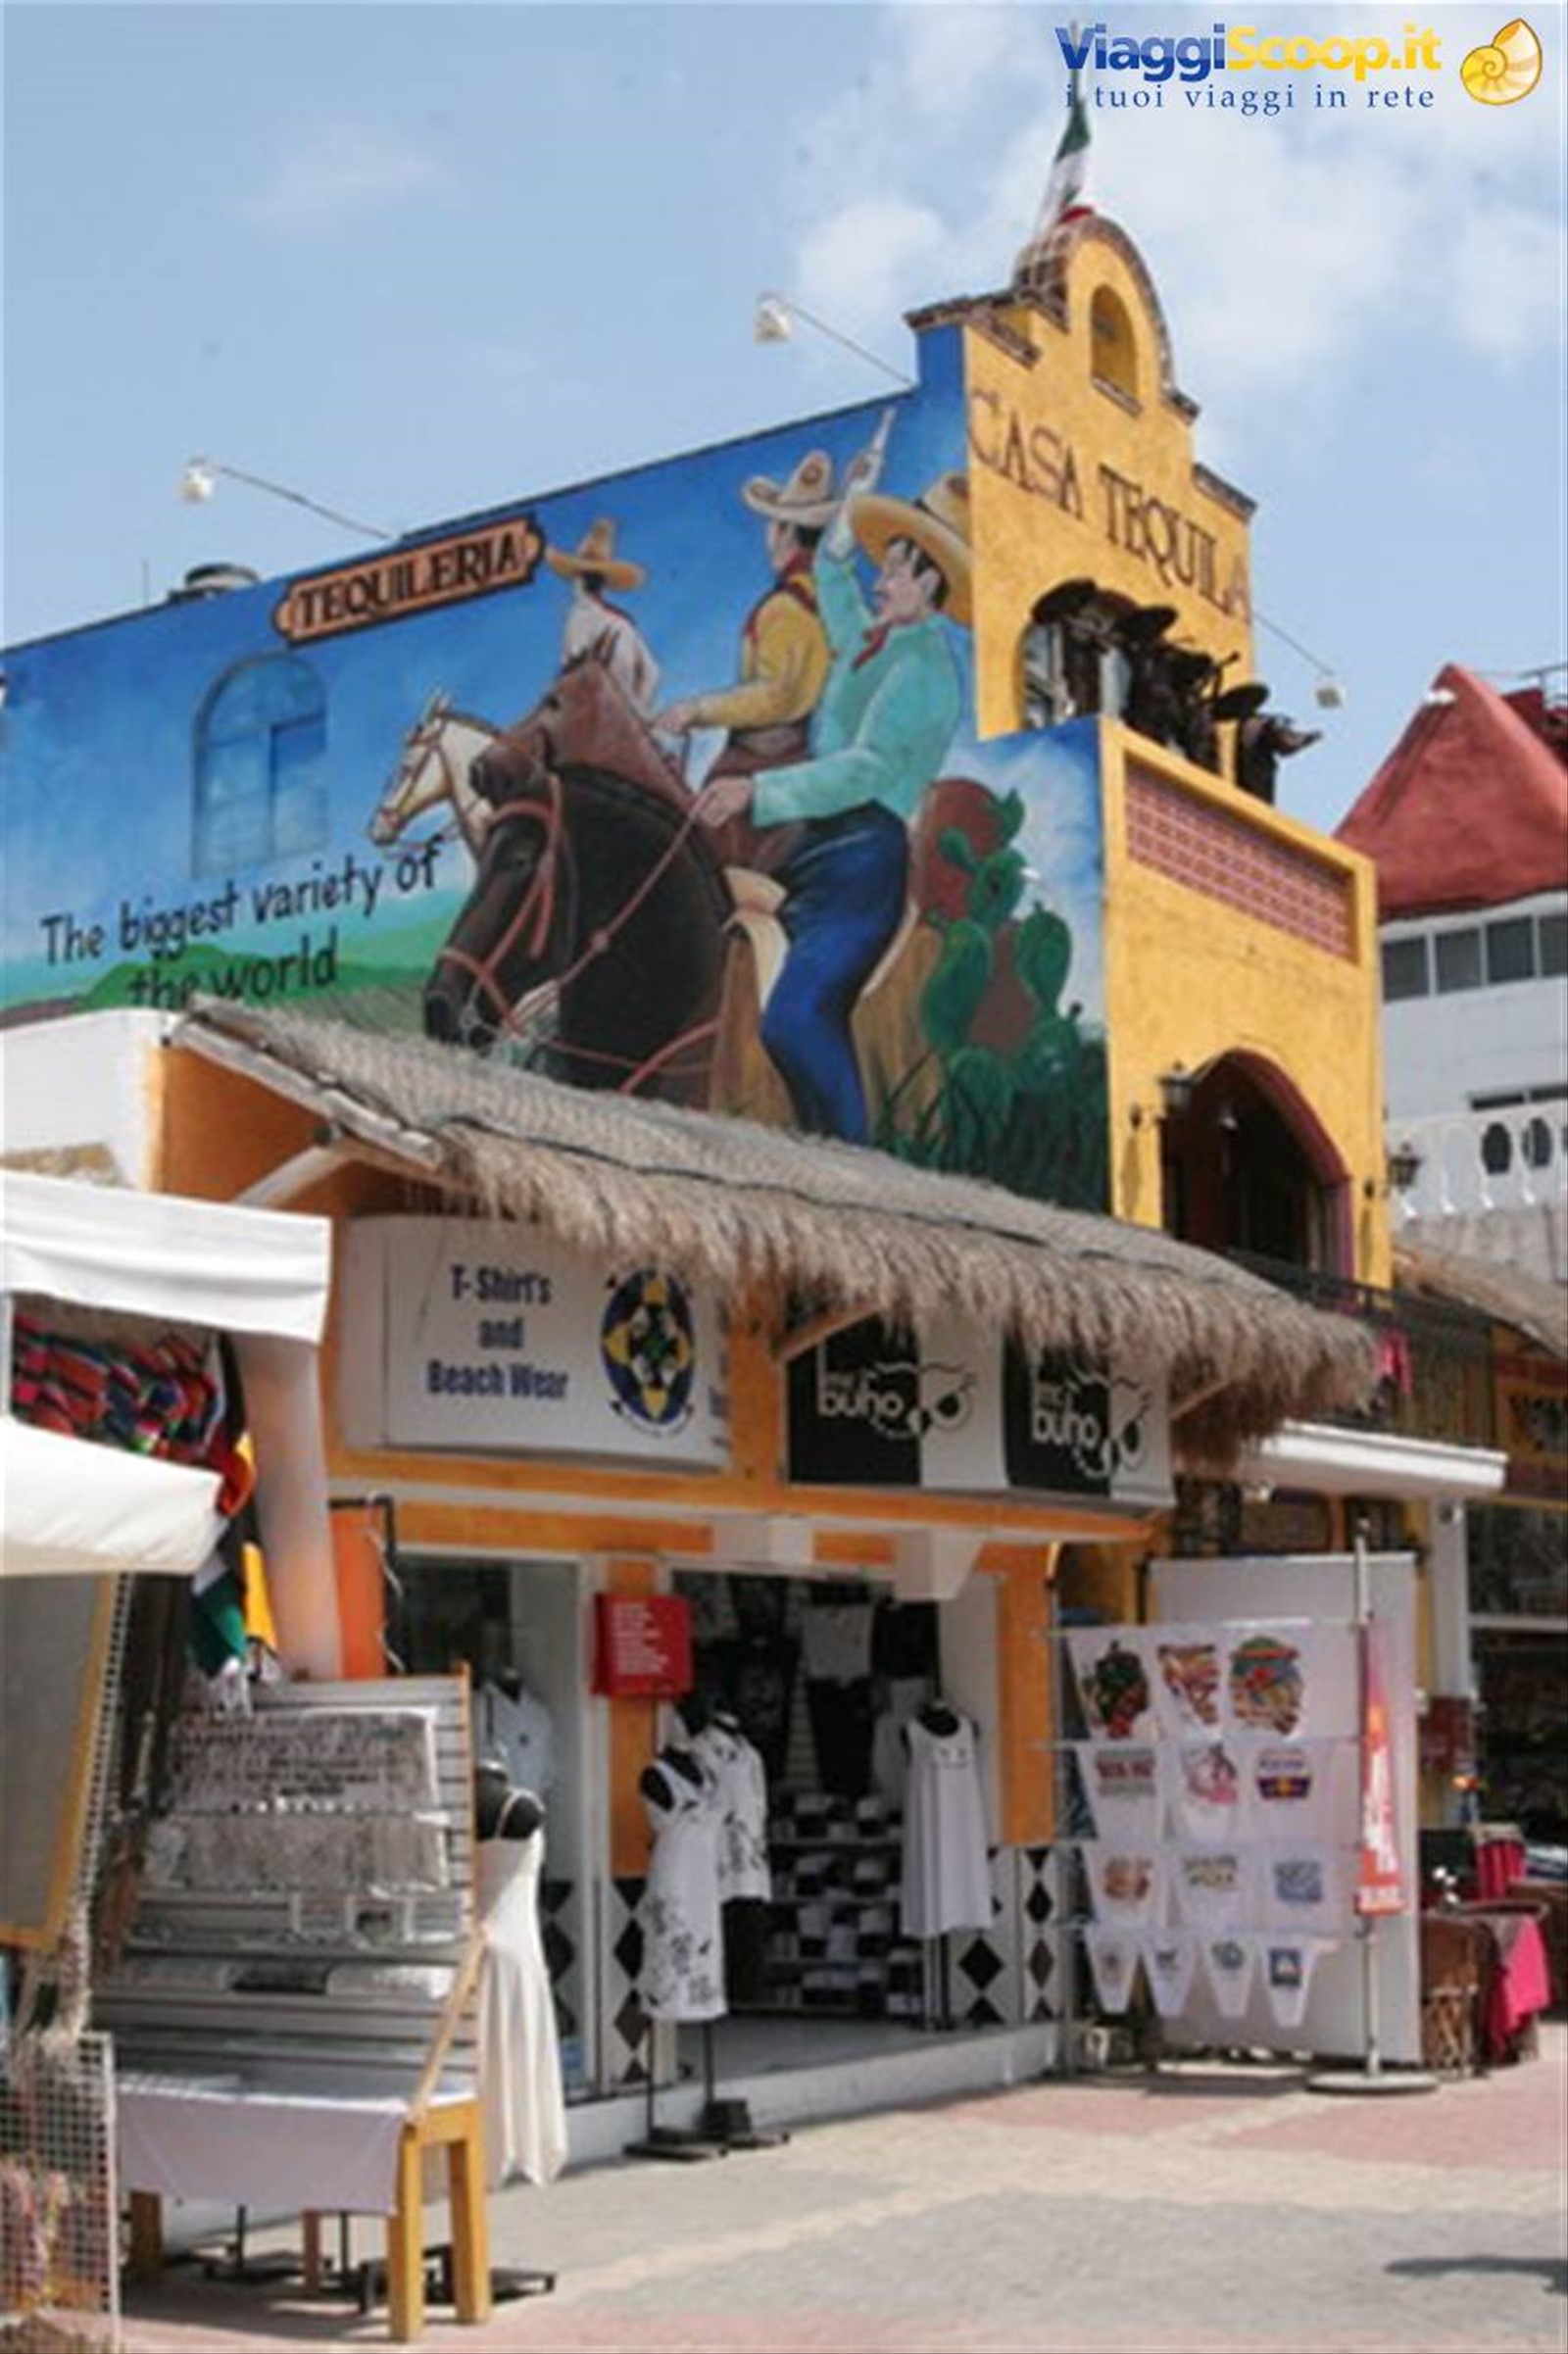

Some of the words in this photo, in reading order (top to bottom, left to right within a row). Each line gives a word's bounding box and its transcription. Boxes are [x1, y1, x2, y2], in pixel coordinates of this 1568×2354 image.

[969, 388, 1084, 521] CASA
[1099, 462, 1251, 624] TEQUILA
[297, 531, 520, 628] TEQUILERIA
[40, 913, 106, 965] The
[119, 879, 239, 959] biggest
[251, 855, 383, 918] variety
[395, 834, 445, 891] of
[125, 966, 200, 1008] the
[209, 925, 339, 1000] world
[478, 1317, 524, 1350] and
[427, 1359, 504, 1398] Beach
[510, 1363, 569, 1400] Wear
